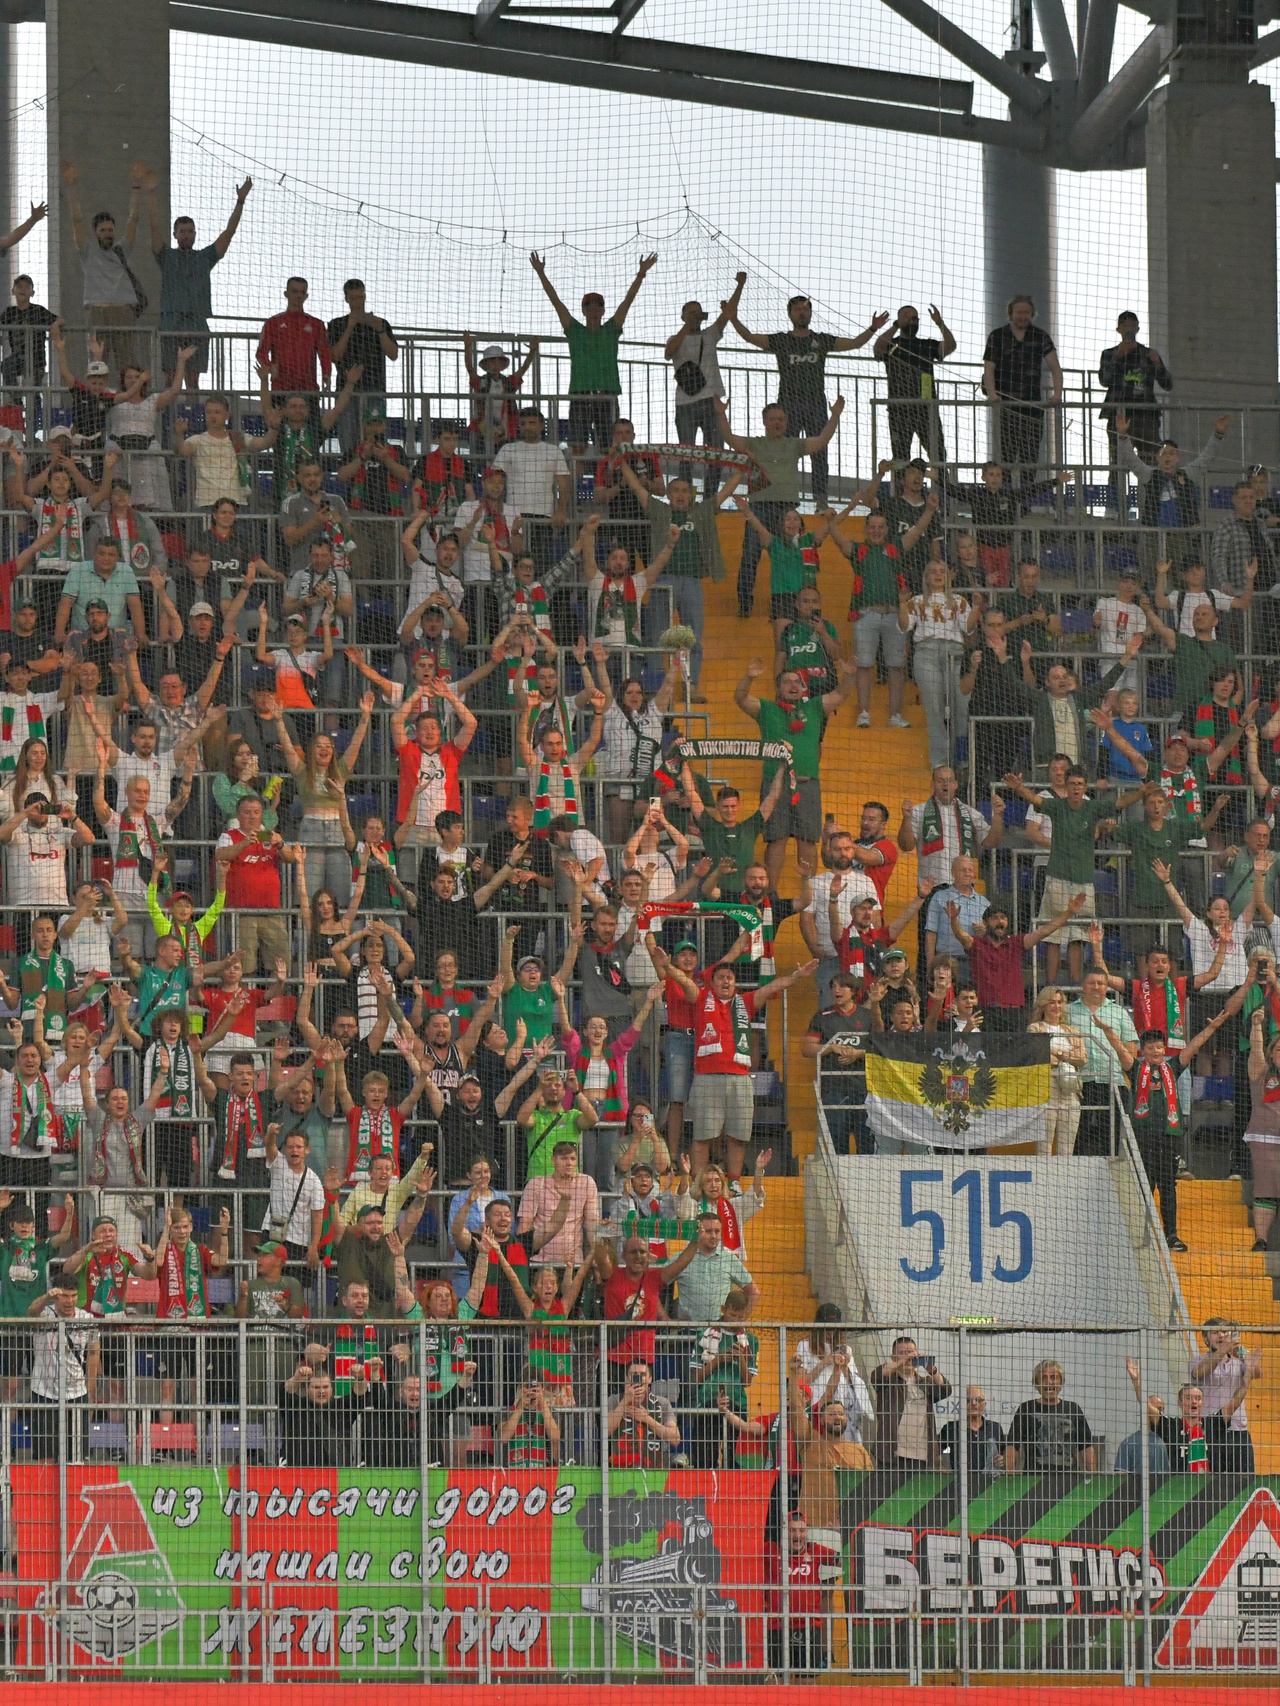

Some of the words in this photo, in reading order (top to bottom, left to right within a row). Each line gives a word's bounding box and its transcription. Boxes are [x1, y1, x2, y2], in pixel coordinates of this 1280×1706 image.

[698, 742, 761, 758] ЛОКОМОТИВ
[899, 1169, 1034, 1284] 515
[151, 1485, 204, 1529] из
[222, 1485, 421, 1520] тысячи
[427, 1483, 577, 1530] дорог
[213, 1548, 373, 1582] нашли
[389, 1534, 511, 1582] свою
[863, 1525, 1165, 1611] БЕРЕГИСЬ
[204, 1604, 542, 1655] ЖЕЛЕЗНУЮ
